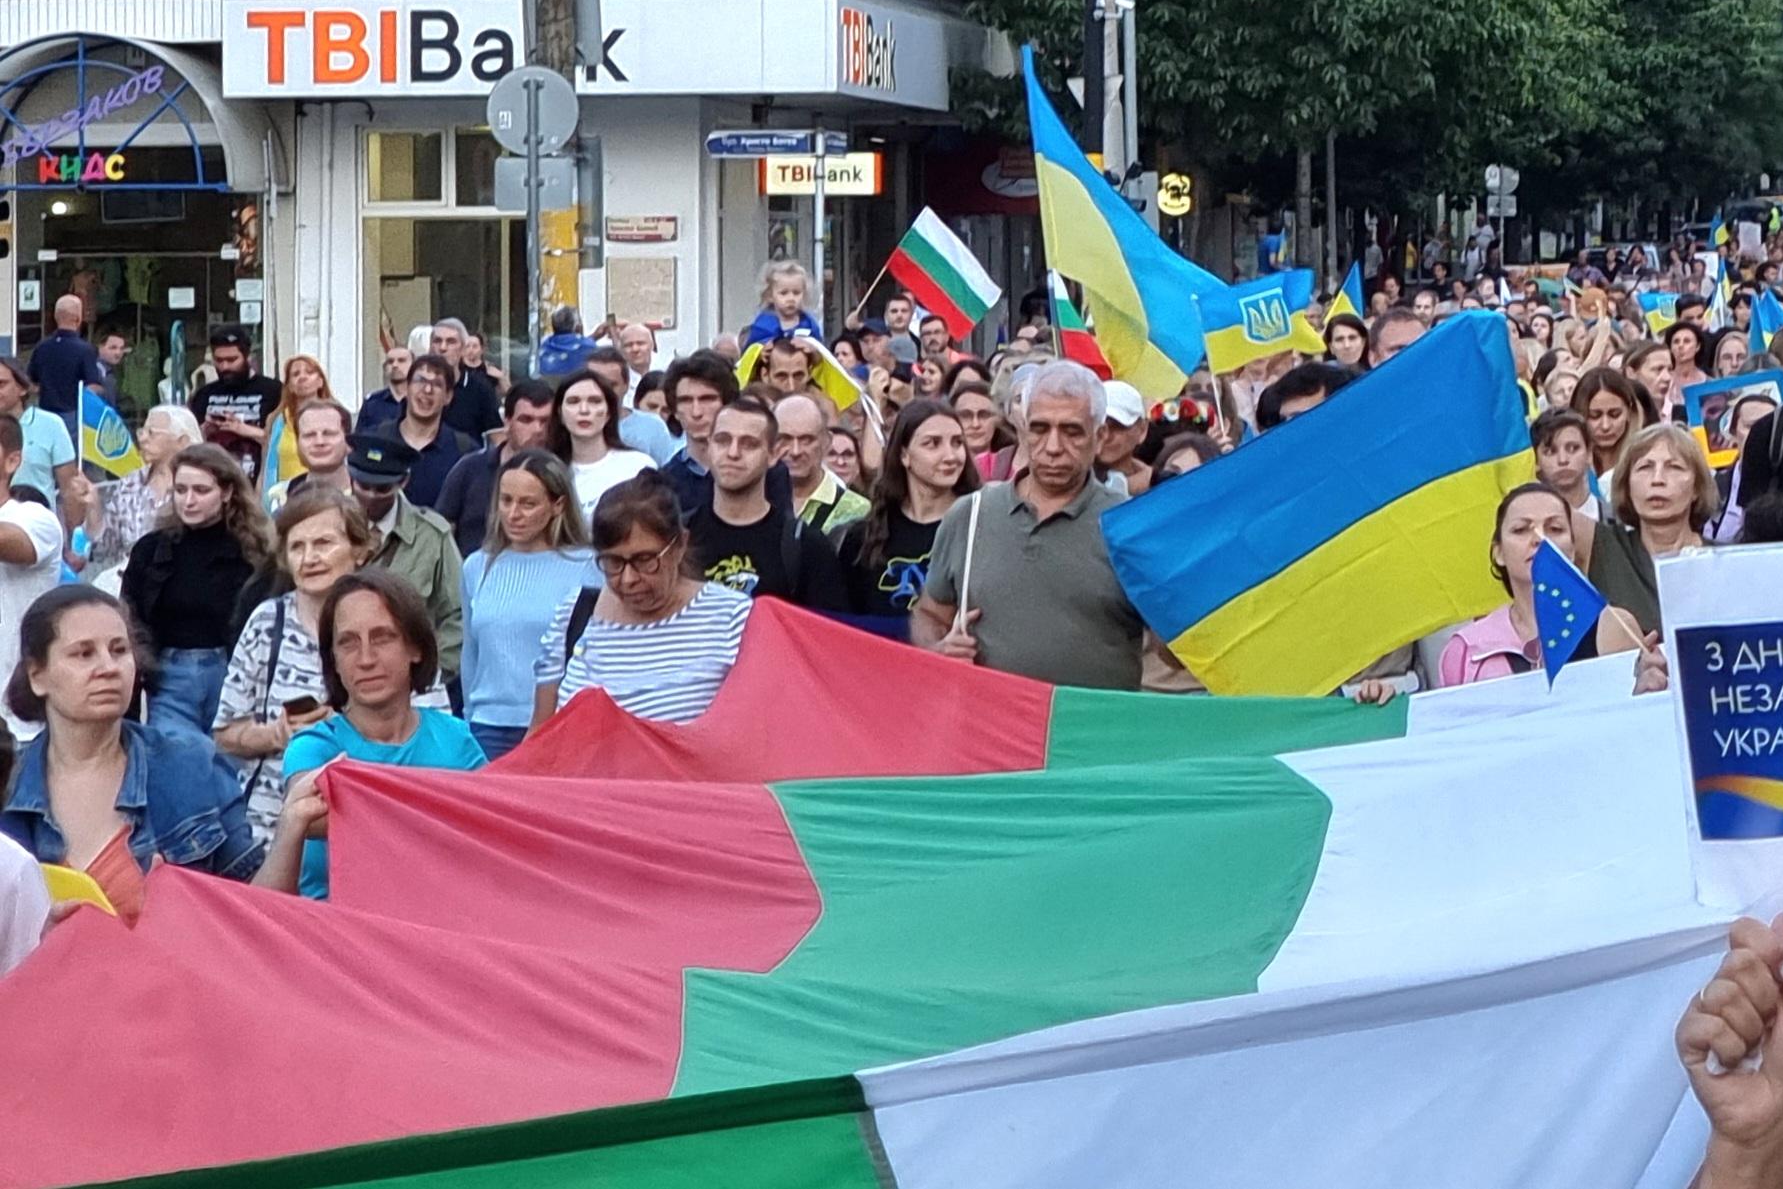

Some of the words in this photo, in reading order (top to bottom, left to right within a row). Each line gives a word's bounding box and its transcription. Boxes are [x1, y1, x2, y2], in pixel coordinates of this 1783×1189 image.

[246, 9, 629, 84] TBIBak
[777, 164, 864, 183] TBIank
[1705, 641, 1724, 672] З
